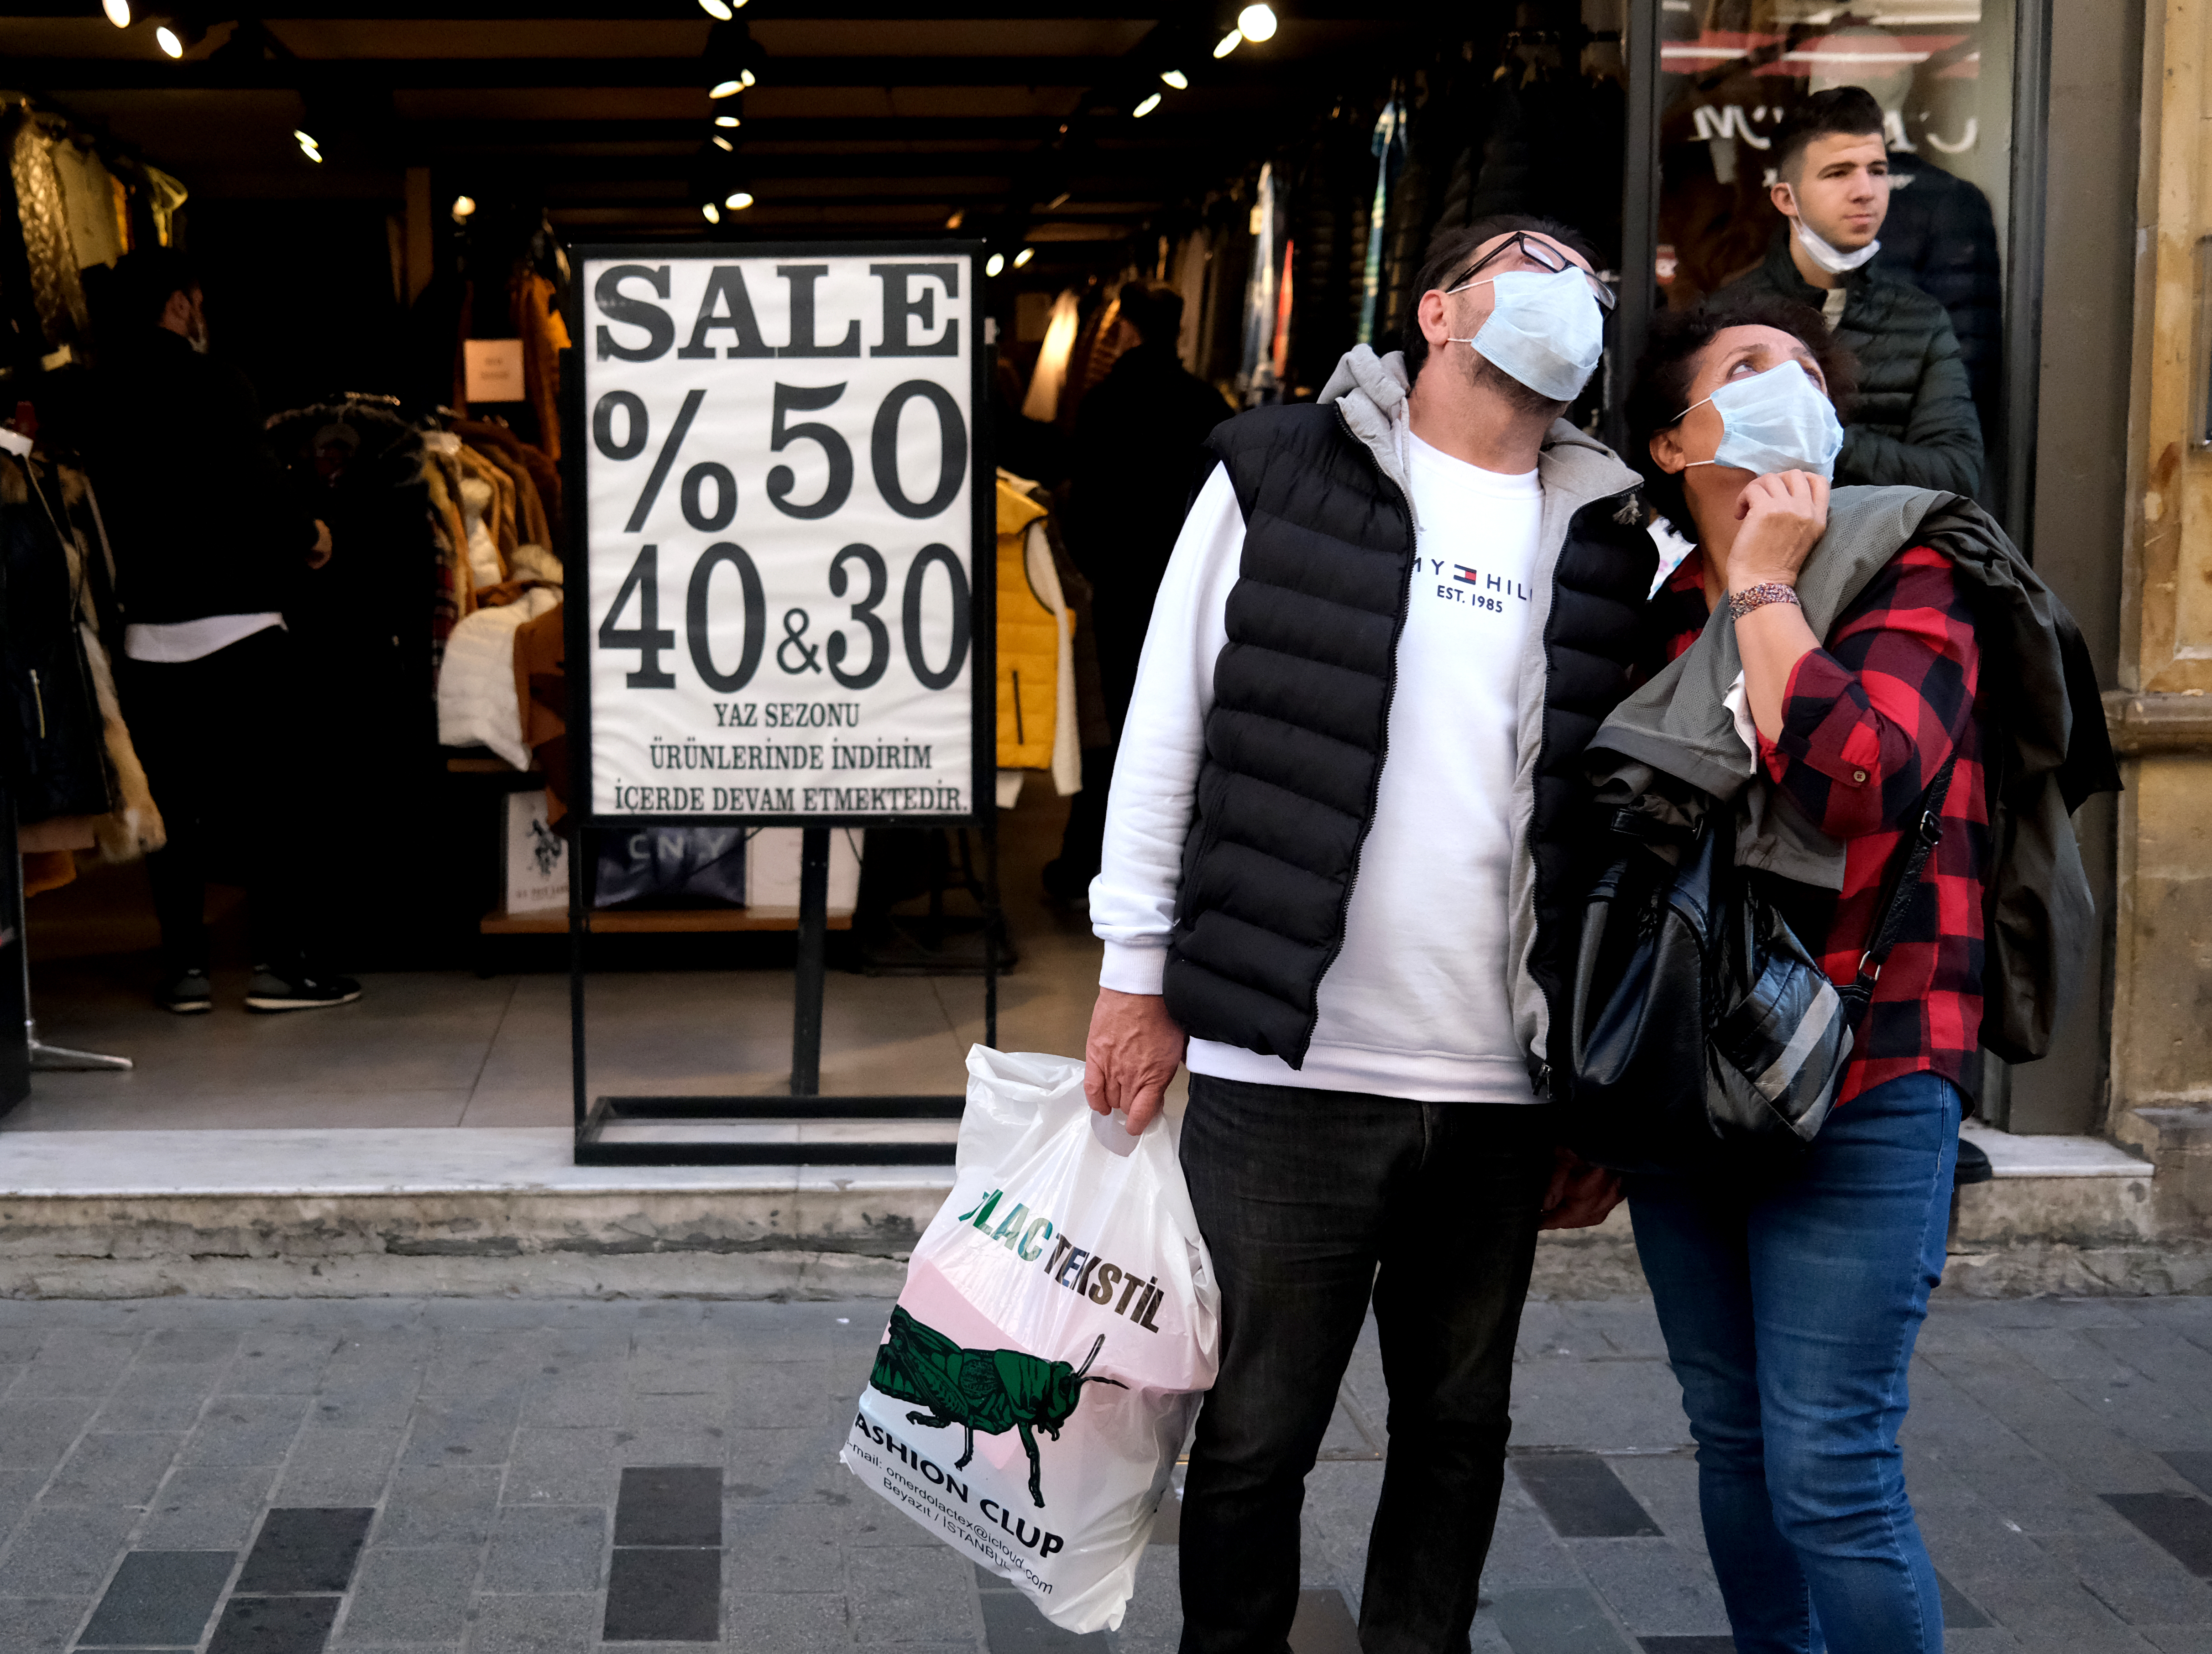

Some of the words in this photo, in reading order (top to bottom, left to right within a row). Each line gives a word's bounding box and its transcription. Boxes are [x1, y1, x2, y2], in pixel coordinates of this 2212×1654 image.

[595, 263, 958, 362] SALE
[593, 389, 737, 533] %
[767, 379, 967, 520] 50
[1437, 585, 1465, 603] EST.
[1472, 594, 1502, 613] 1985
[1487, 574, 1532, 602] HIL
[714, 703, 757, 727] YAZ
[765, 703, 860, 727] SEZONU
[650, 737, 822, 770] ÜRÜNLERİNDE
[832, 737, 932, 770] İNDİRİM
[615, 778, 705, 814] İÇERDE
[712, 788, 795, 812] DEVAM
[803, 780, 968, 812] ETMEKTEDİR.
[980, 1499, 1064, 1558] CLUP
